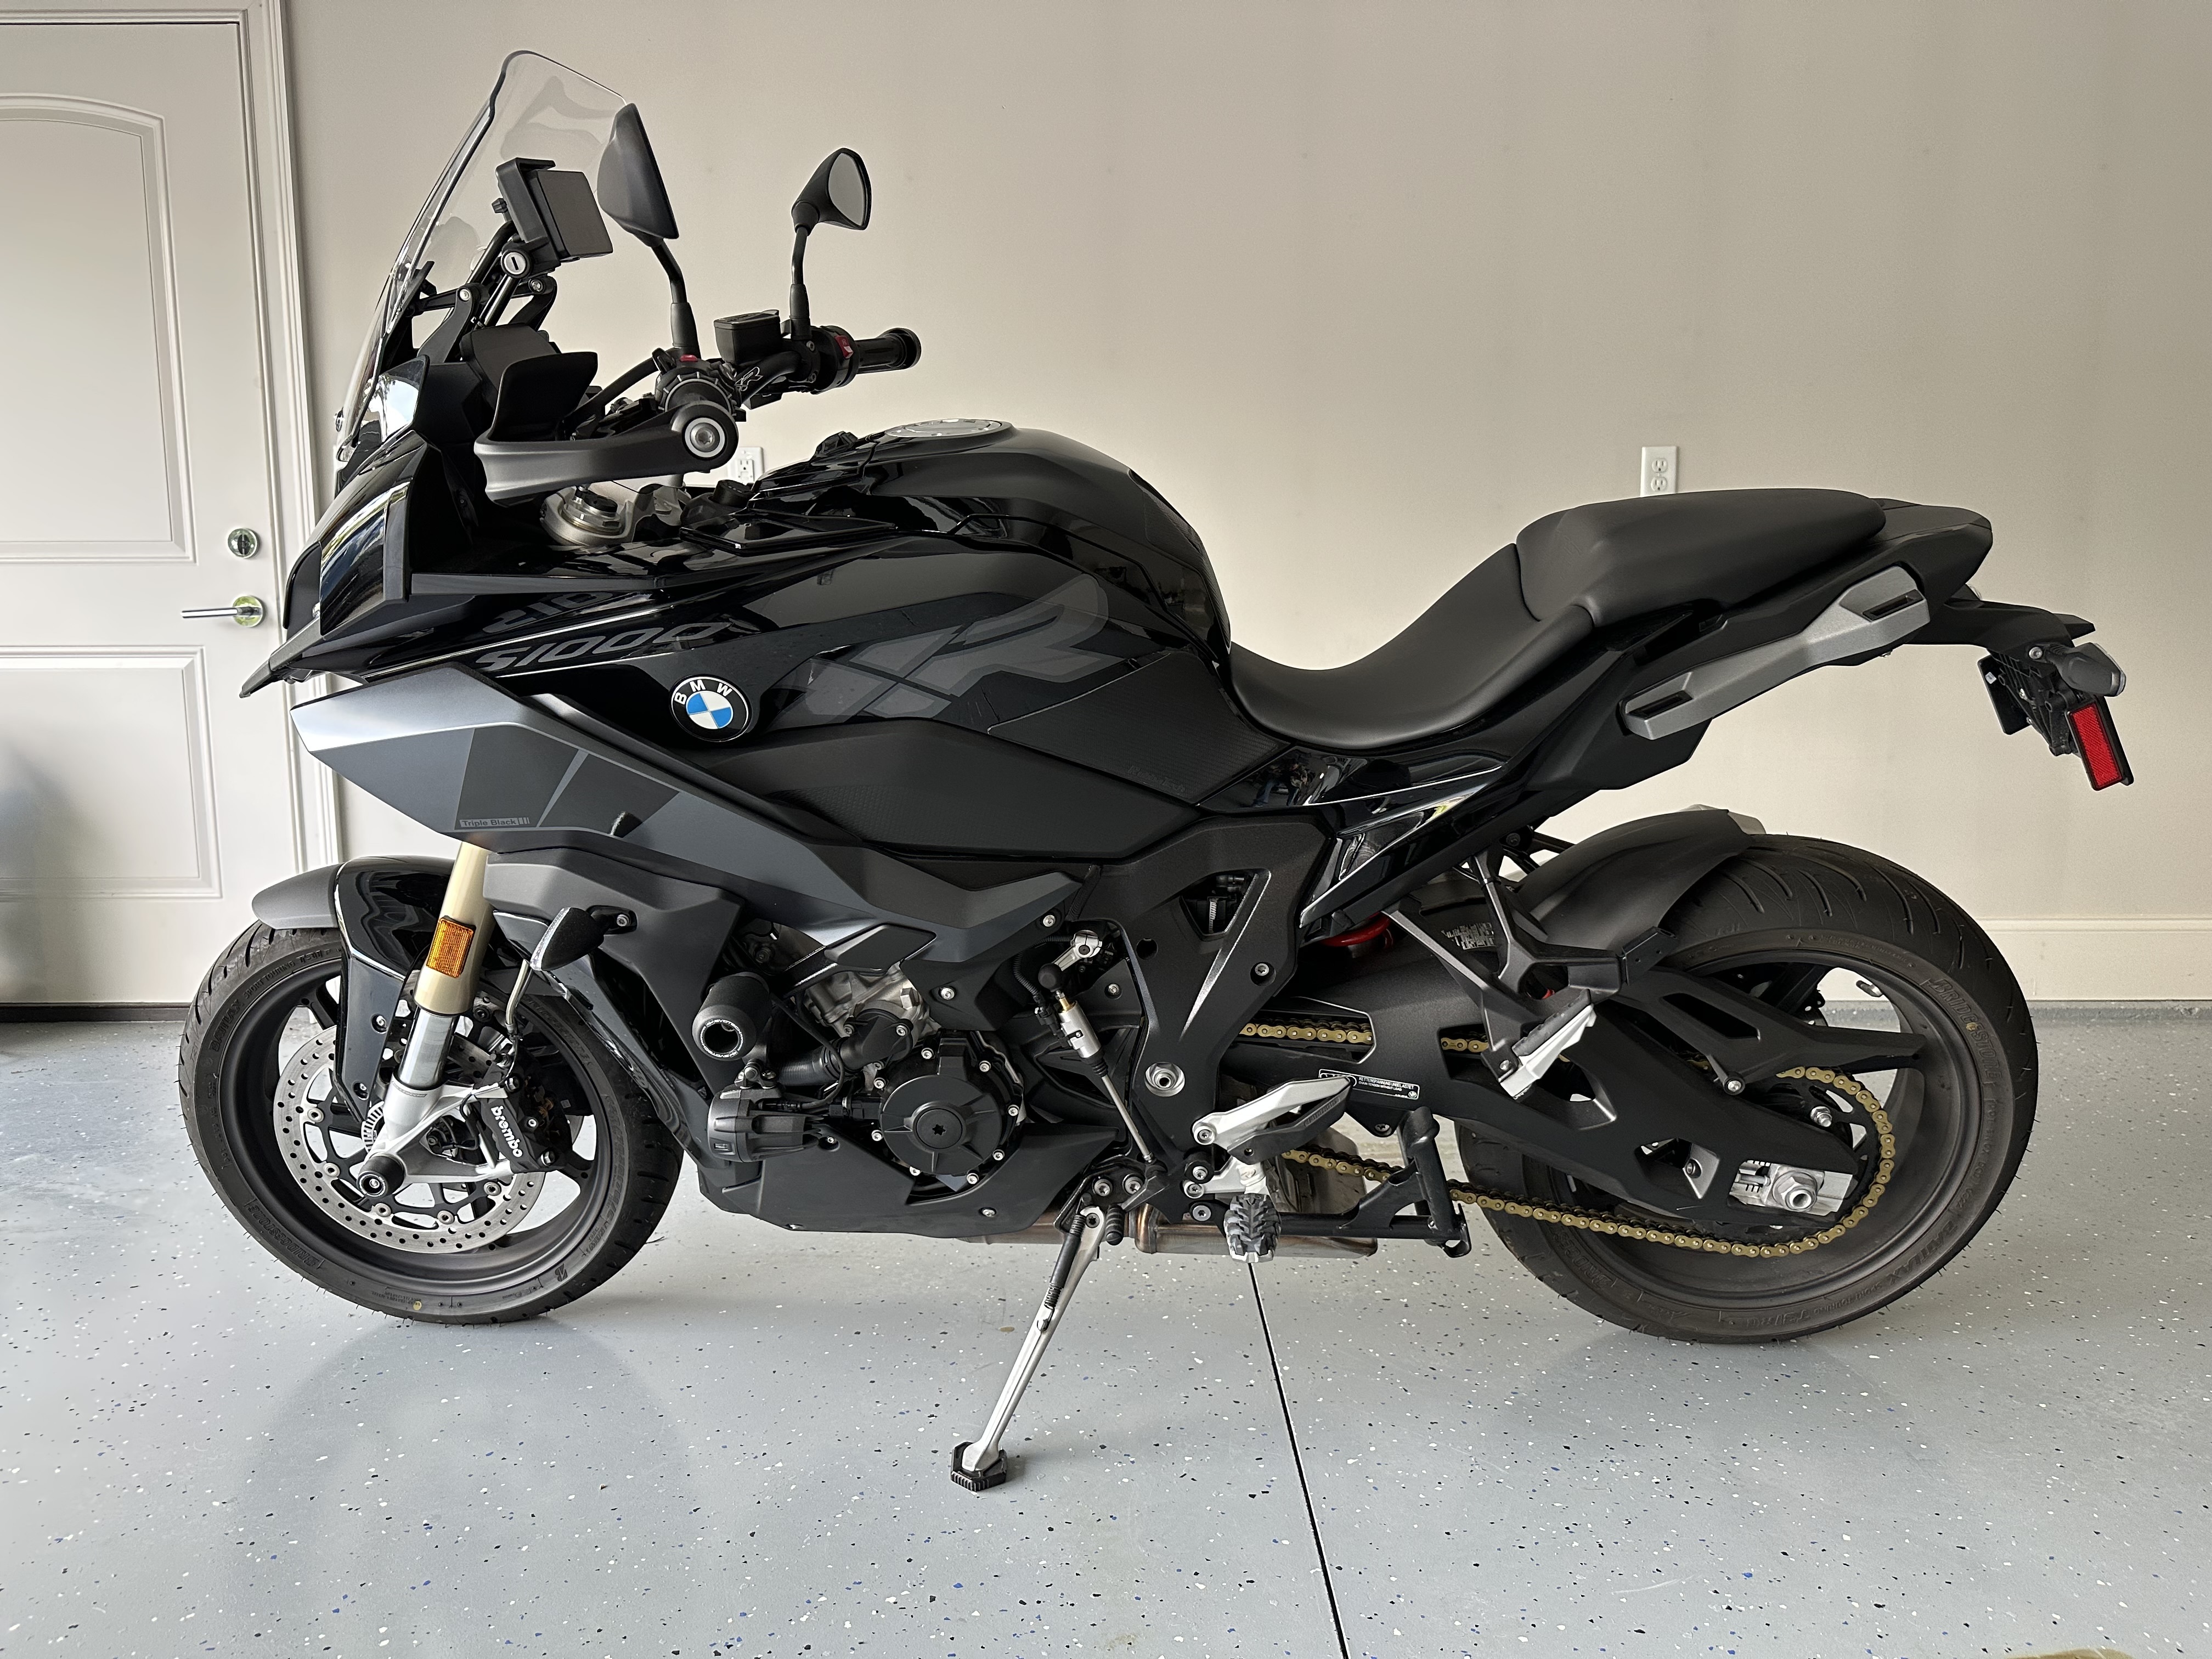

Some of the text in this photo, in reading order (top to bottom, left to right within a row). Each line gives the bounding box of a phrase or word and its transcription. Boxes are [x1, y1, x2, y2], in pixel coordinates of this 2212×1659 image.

[674, 679, 732, 705] BMW
[208, 998, 245, 1053] BATTLAX
[240, 977, 266, 1000] SPORT
[490, 1105, 523, 1158] brembo
[245, 1203, 319, 1268] BRIDGESTONE
[1883, 1220, 1960, 1285] BATTLAX
